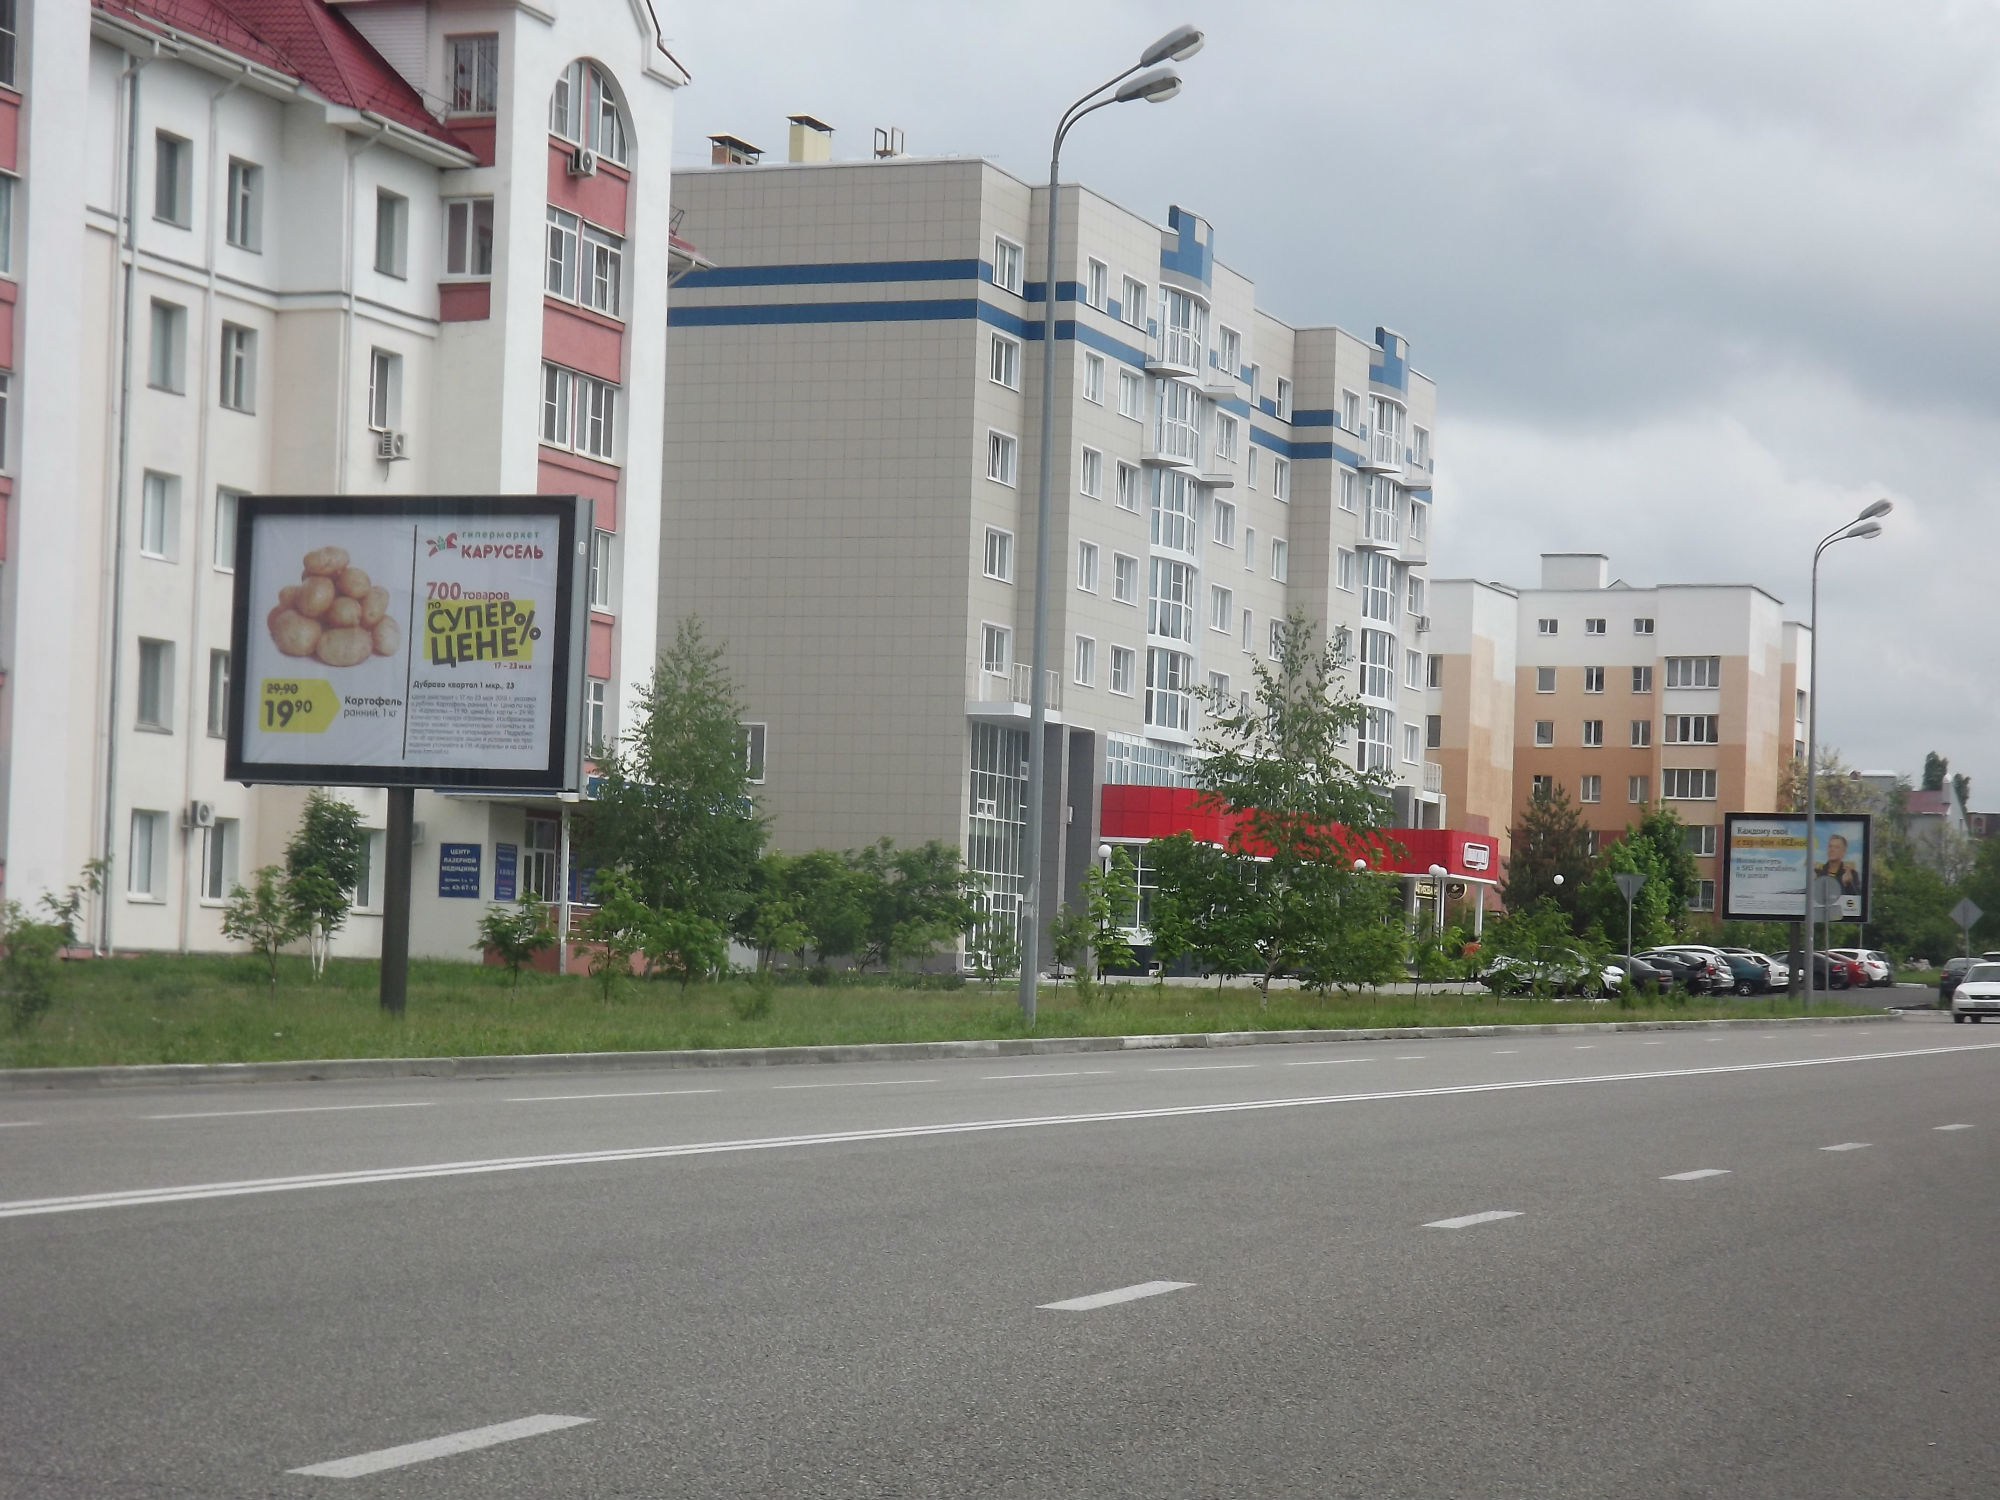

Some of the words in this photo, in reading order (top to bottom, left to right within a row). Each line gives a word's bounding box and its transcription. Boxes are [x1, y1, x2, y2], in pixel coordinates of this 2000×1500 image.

[461, 531, 540, 540] гипермаркет
[461, 544, 544, 560] КАРУСЕЛЬ
[426, 582, 462, 600] 700
[462, 592, 510, 602] товаров
[428, 601, 441, 610] по
[428, 600, 516, 634] СУПЕР
[431, 626, 518, 668] ЦЕНЕ
[413, 680, 446, 688] Дубрава
[344, 696, 402, 707] Картофель
